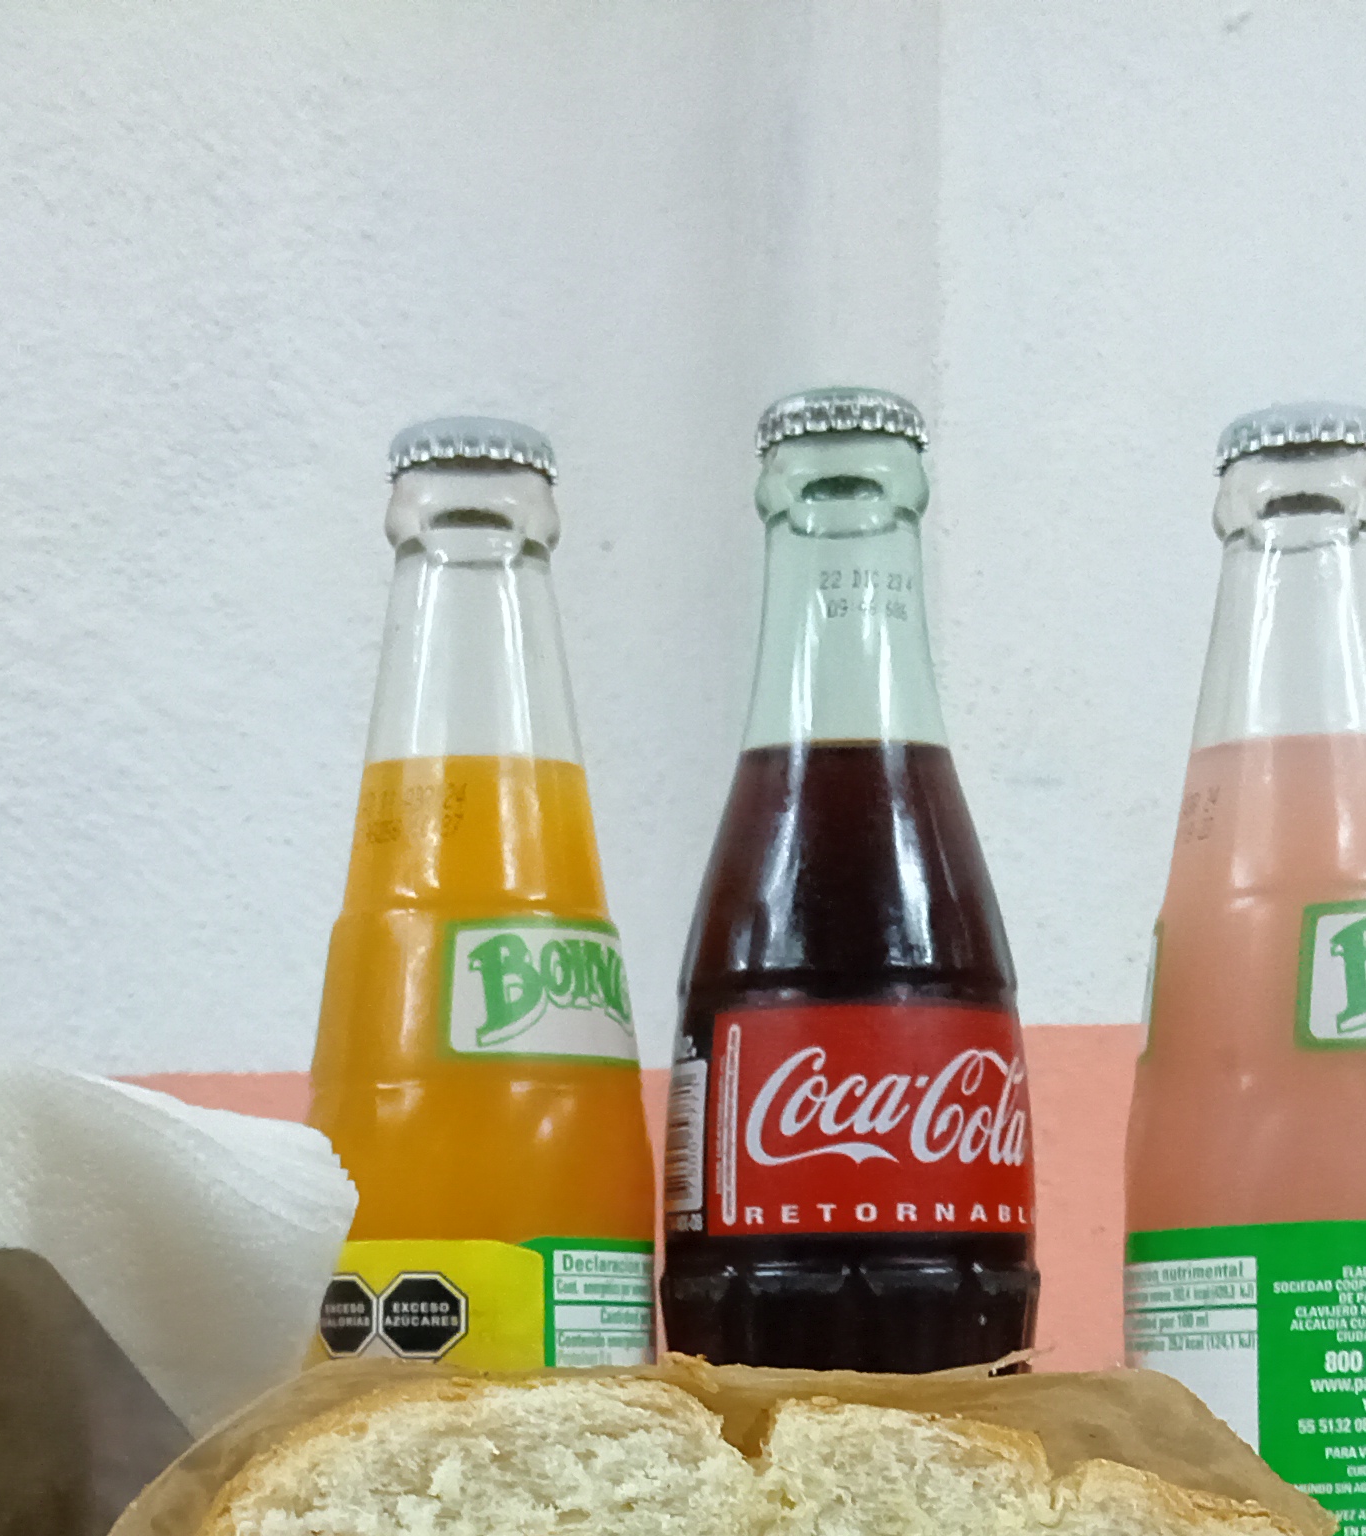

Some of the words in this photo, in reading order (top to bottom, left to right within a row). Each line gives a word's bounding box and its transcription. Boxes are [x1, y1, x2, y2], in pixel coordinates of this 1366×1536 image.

[819, 570, 842, 590] 22
[1273, 1280, 1333, 1294] SOCIEDAD
[1339, 1292, 1354, 1305] DE
[392, 1302, 450, 1313] EXCESO
[1324, 1350, 1364, 1373] 800
[1297, 1418, 1316, 1434] 55
[1318, 1417, 1352, 1434] 5132
[1325, 1446, 1357, 1459] PARA
